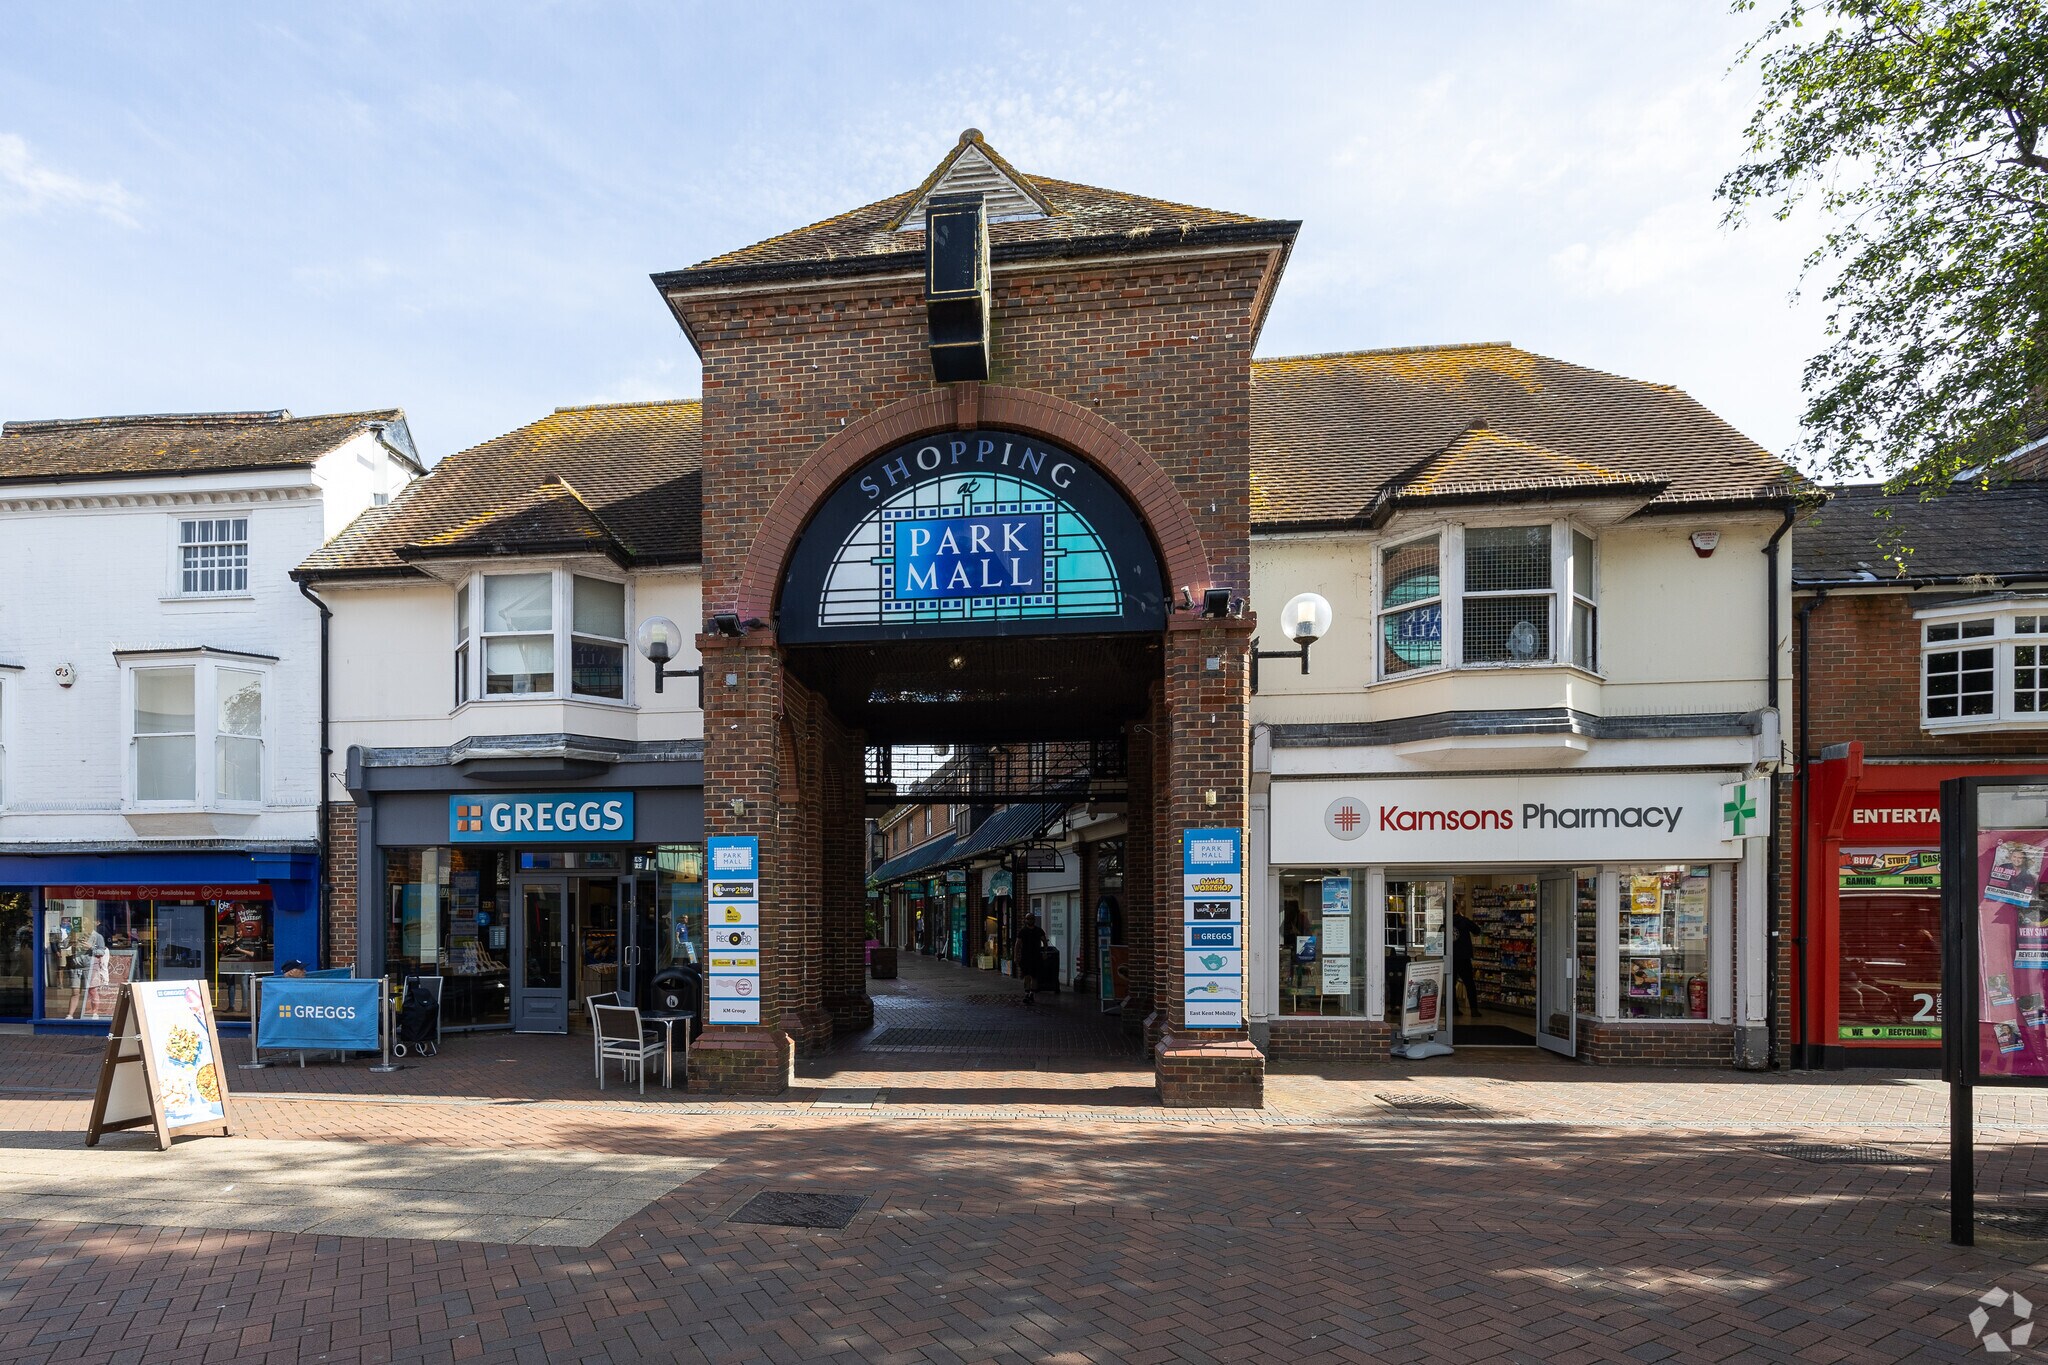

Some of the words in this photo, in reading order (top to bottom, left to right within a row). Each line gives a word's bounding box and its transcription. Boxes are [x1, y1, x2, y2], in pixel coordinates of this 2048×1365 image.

[859, 439, 1076, 499] SHOPPING
[957, 478, 981, 495] at
[910, 522, 1028, 557] PARK
[905, 557, 1033, 591] MALL
[489, 800, 624, 832] GREGGS
[1380, 805, 1514, 831] Kamsons
[1522, 803, 1683, 833] Pharmacy
[1853, 808, 1941, 824] ENTERTA
[1853, 856, 1869, 865] BUY
[1887, 856, 1908, 865] STUFF
[1200, 877, 1225, 885] GAMES
[1845, 877, 1877, 885] GAMING
[1903, 876, 1933, 885] PHONES
[1192, 884, 1233, 893] WORKSHOP
[2019, 927, 2033, 936] VERY
[2034, 927, 2048, 936] SAN
[294, 1005, 356, 1019] GREGGS
[1912, 993, 1935, 1022] 2
[1852, 1028, 1864, 1036] WE
[1888, 1028, 1928, 1037] RECYCLING
